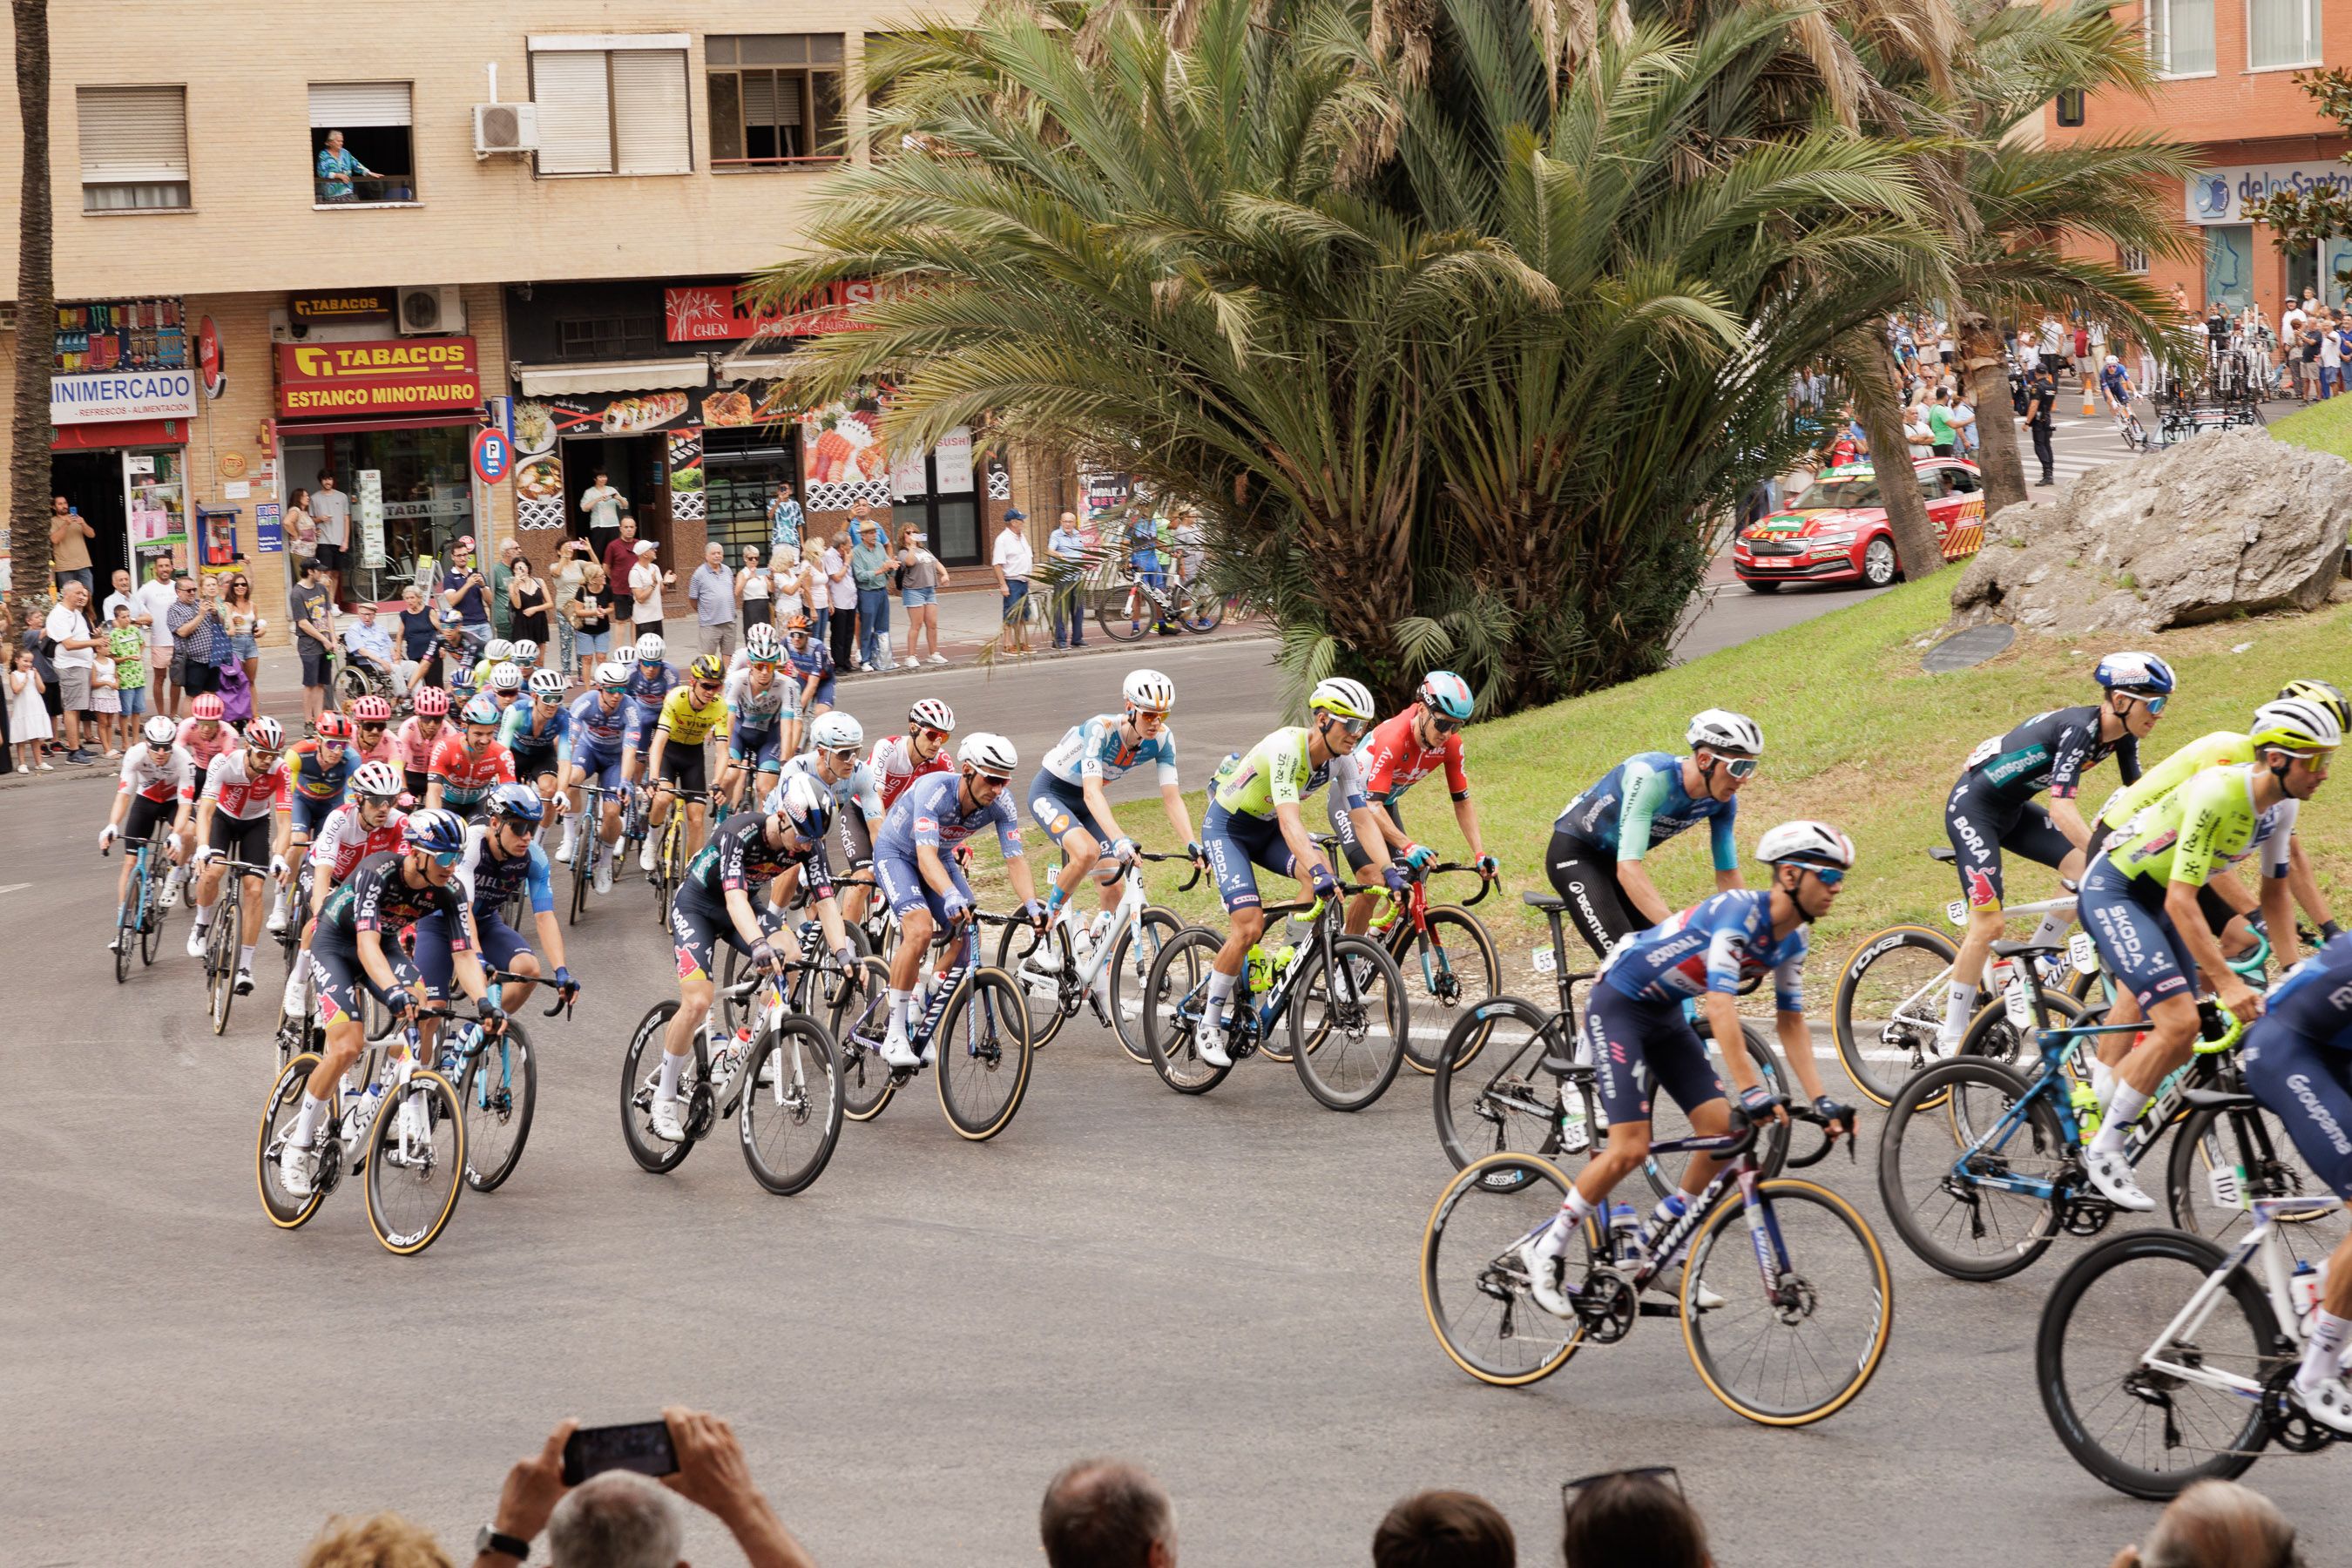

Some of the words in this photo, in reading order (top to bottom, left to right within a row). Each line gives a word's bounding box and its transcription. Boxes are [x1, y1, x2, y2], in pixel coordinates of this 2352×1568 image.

[311, 298, 378, 310] TABACOS
[693, 323, 727, 337] CHEN
[336, 345, 465, 367] TABACOS
[79, 407, 126, 417] REFRESCOS
[287, 389, 368, 408] ESTANCO
[372, 383, 475, 403] MINOTAURO
[490, 443, 497, 456] P
[430, 740, 449, 767] dstny
[1369, 746, 1394, 782] dstny
[1987, 749, 2047, 783] hansgrohe
[2057, 747, 2085, 782] BOSS
[321, 815, 347, 854] Cofidis
[738, 822, 758, 839] BORA
[840, 814, 856, 859] Cofidis
[1335, 809, 1355, 845] dstny
[1953, 815, 1991, 864] BORA
[376, 860, 396, 875] BORA
[727, 847, 744, 876] BOSS
[808, 855, 824, 886] BOSS
[1212, 839, 1229, 884] SKODA
[361, 883, 382, 918] BOSS
[1950, 902, 1962, 919] 63
[457, 902, 471, 937] BOSS
[672, 909, 695, 942] BORA
[1577, 894, 1615, 954] DECATHLO
[2108, 904, 2146, 968] SKODA
[1539, 955, 1551, 970] 55
[1850, 934, 1905, 980] roval
[2074, 938, 2091, 963] 153
[1267, 931, 1315, 1010] CUBE
[918, 967, 964, 1037] CANYON
[2123, 1062, 2202, 1162] CUBE
[2286, 1074, 2352, 1155] Groupama
[2216, 1175, 2239, 1203] 102
[387, 1225, 428, 1247] roval
